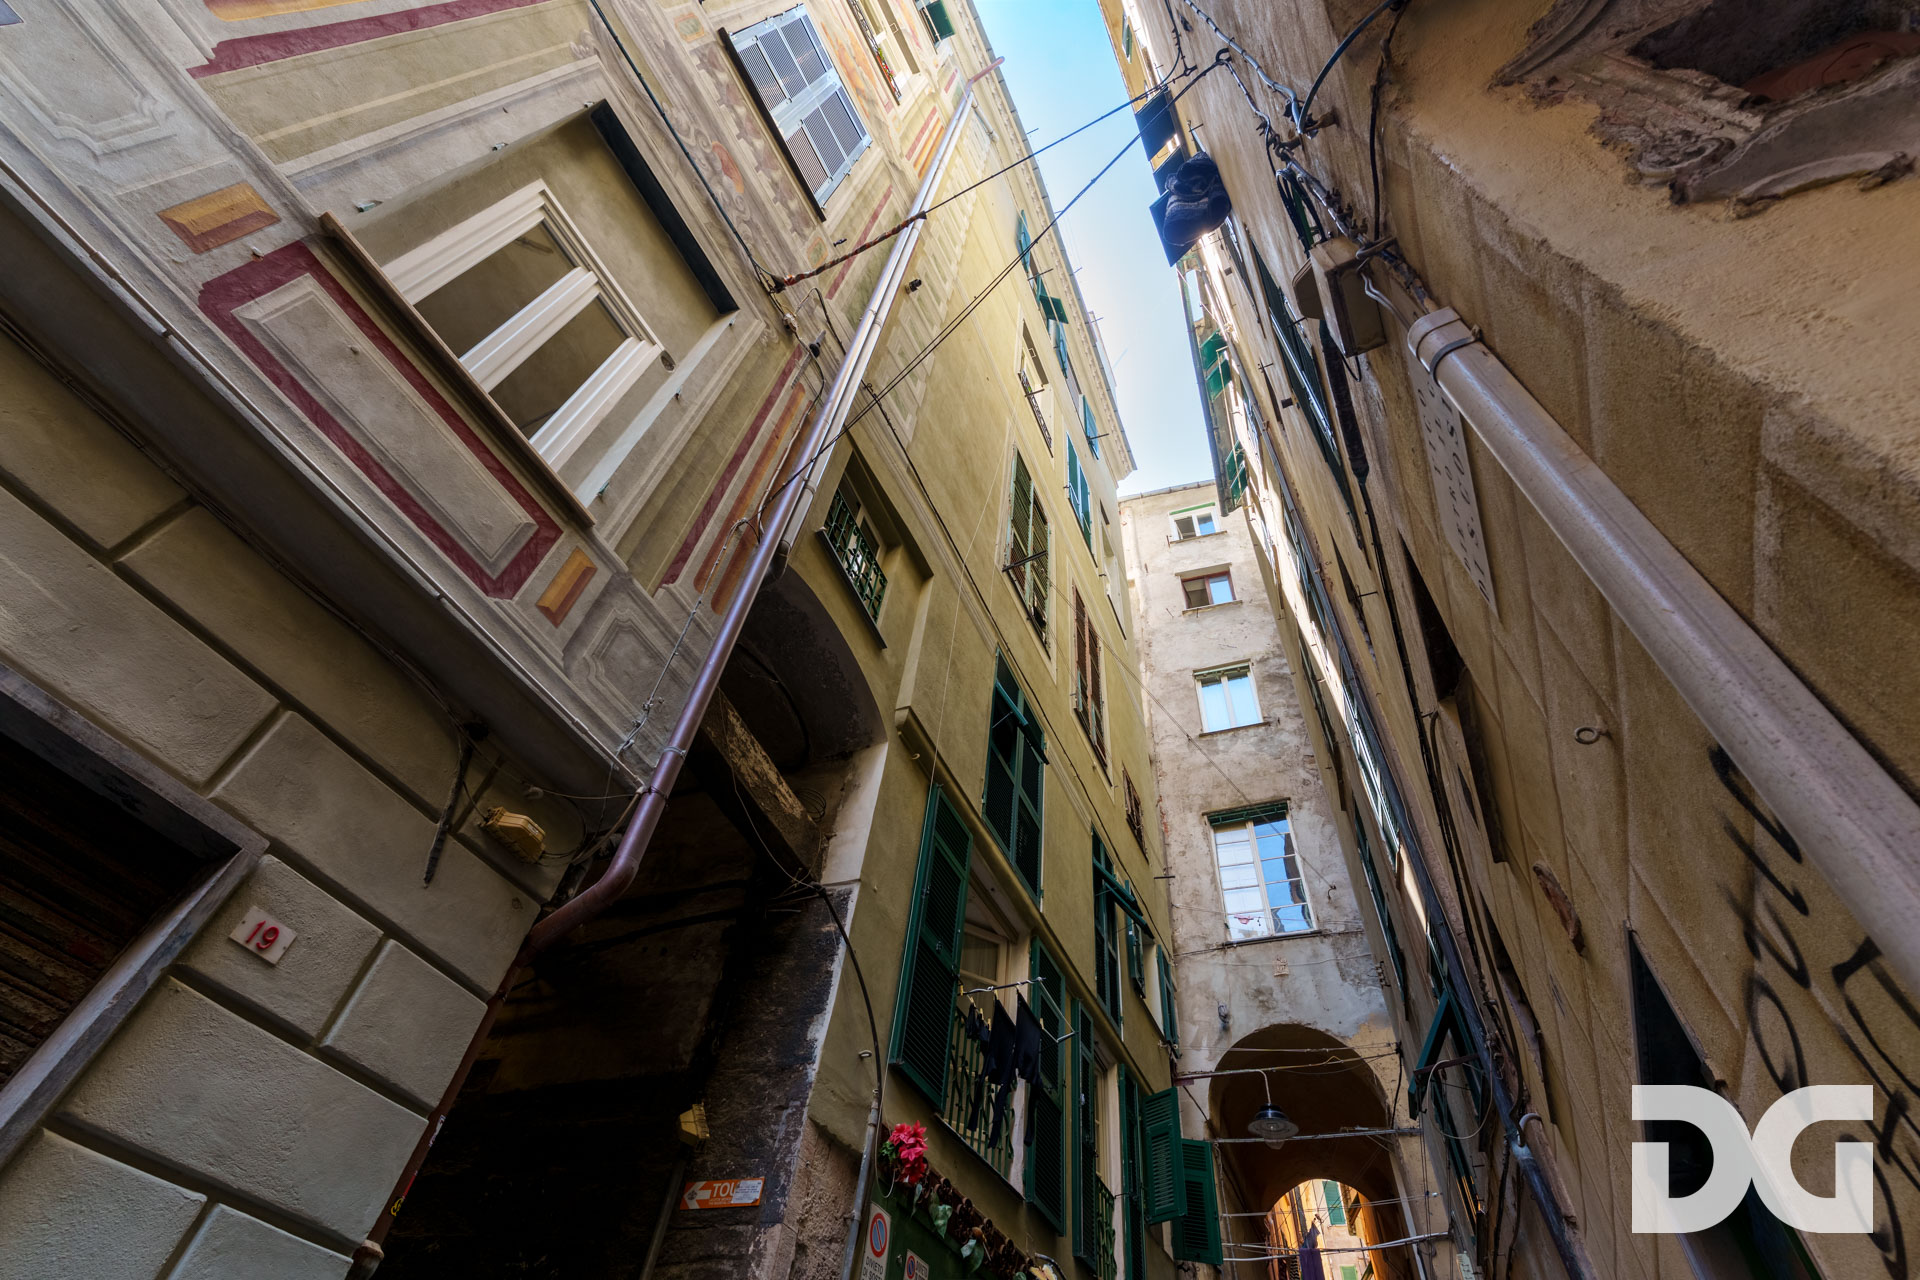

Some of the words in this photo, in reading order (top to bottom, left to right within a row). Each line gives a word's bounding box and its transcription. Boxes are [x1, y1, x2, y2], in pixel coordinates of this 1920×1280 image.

[1441, 396, 1480, 550] S.COSI
[245, 920, 280, 950] 19
[866, 1256, 884, 1275] DIVIETO
